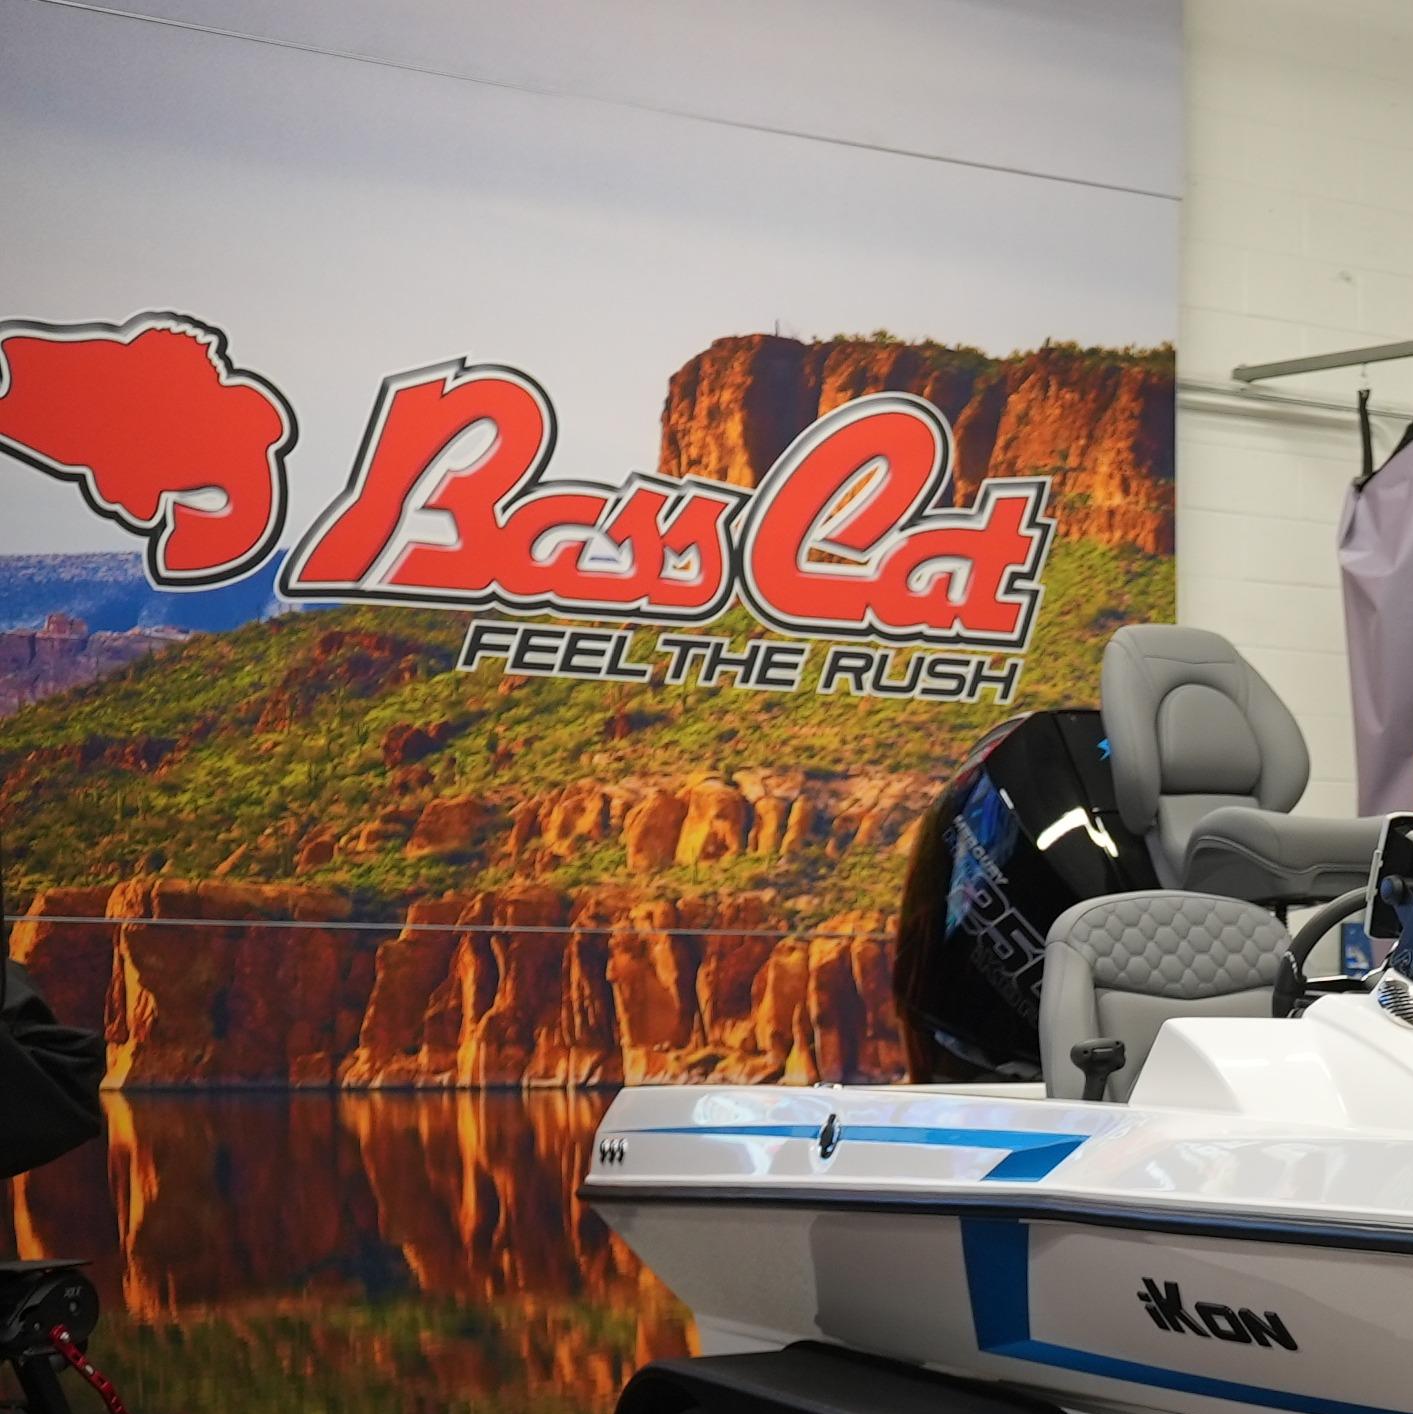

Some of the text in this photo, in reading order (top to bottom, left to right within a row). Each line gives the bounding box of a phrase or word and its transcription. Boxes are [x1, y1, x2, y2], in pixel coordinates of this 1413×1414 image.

[280, 360, 1052, 648] Bass Cat
[461, 624, 1019, 702] FEEL THE RUSH
